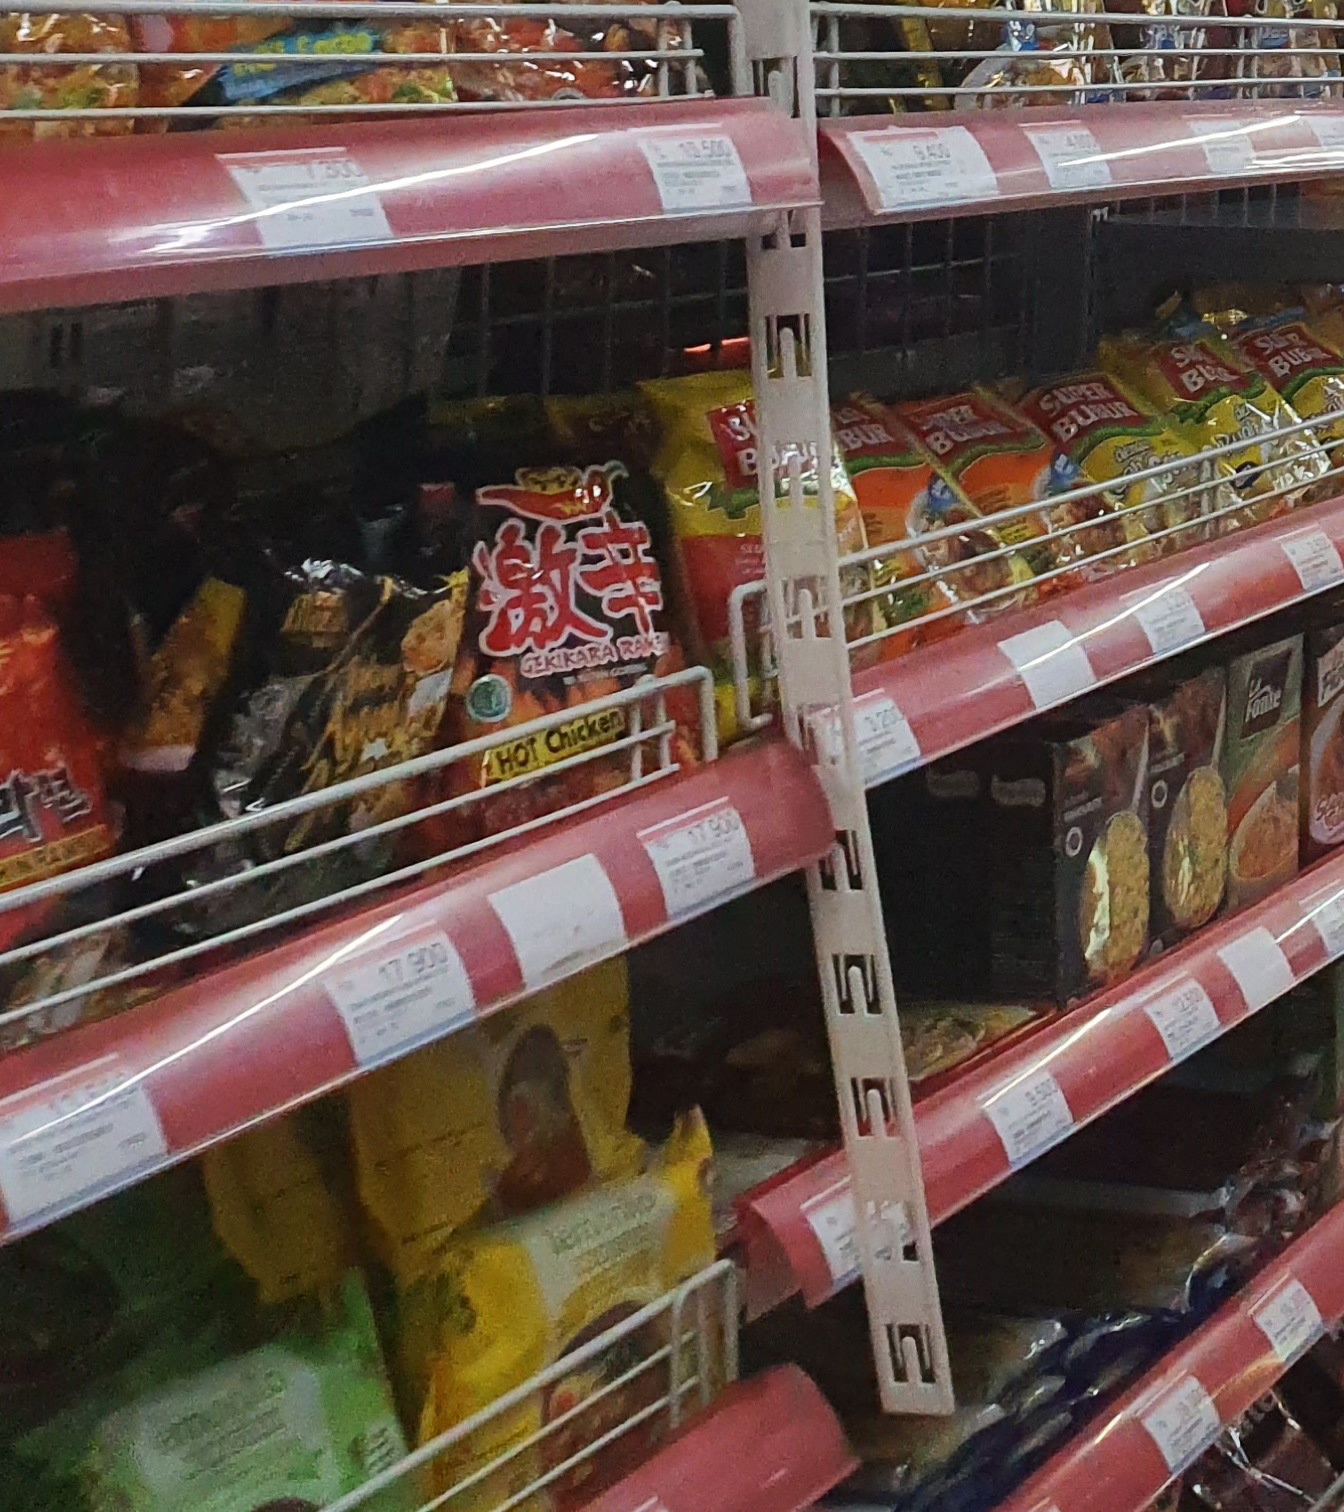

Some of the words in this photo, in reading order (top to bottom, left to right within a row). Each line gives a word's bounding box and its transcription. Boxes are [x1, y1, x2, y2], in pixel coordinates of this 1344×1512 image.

[1039, 383, 1116, 416] SUPER
[1053, 400, 1139, 442] BUBUR
[476, 511, 662, 655] 激辛
[523, 643, 617, 676] GEKIKARA
[496, 738, 538, 772] HOT
[546, 709, 624, 754] Chicken
